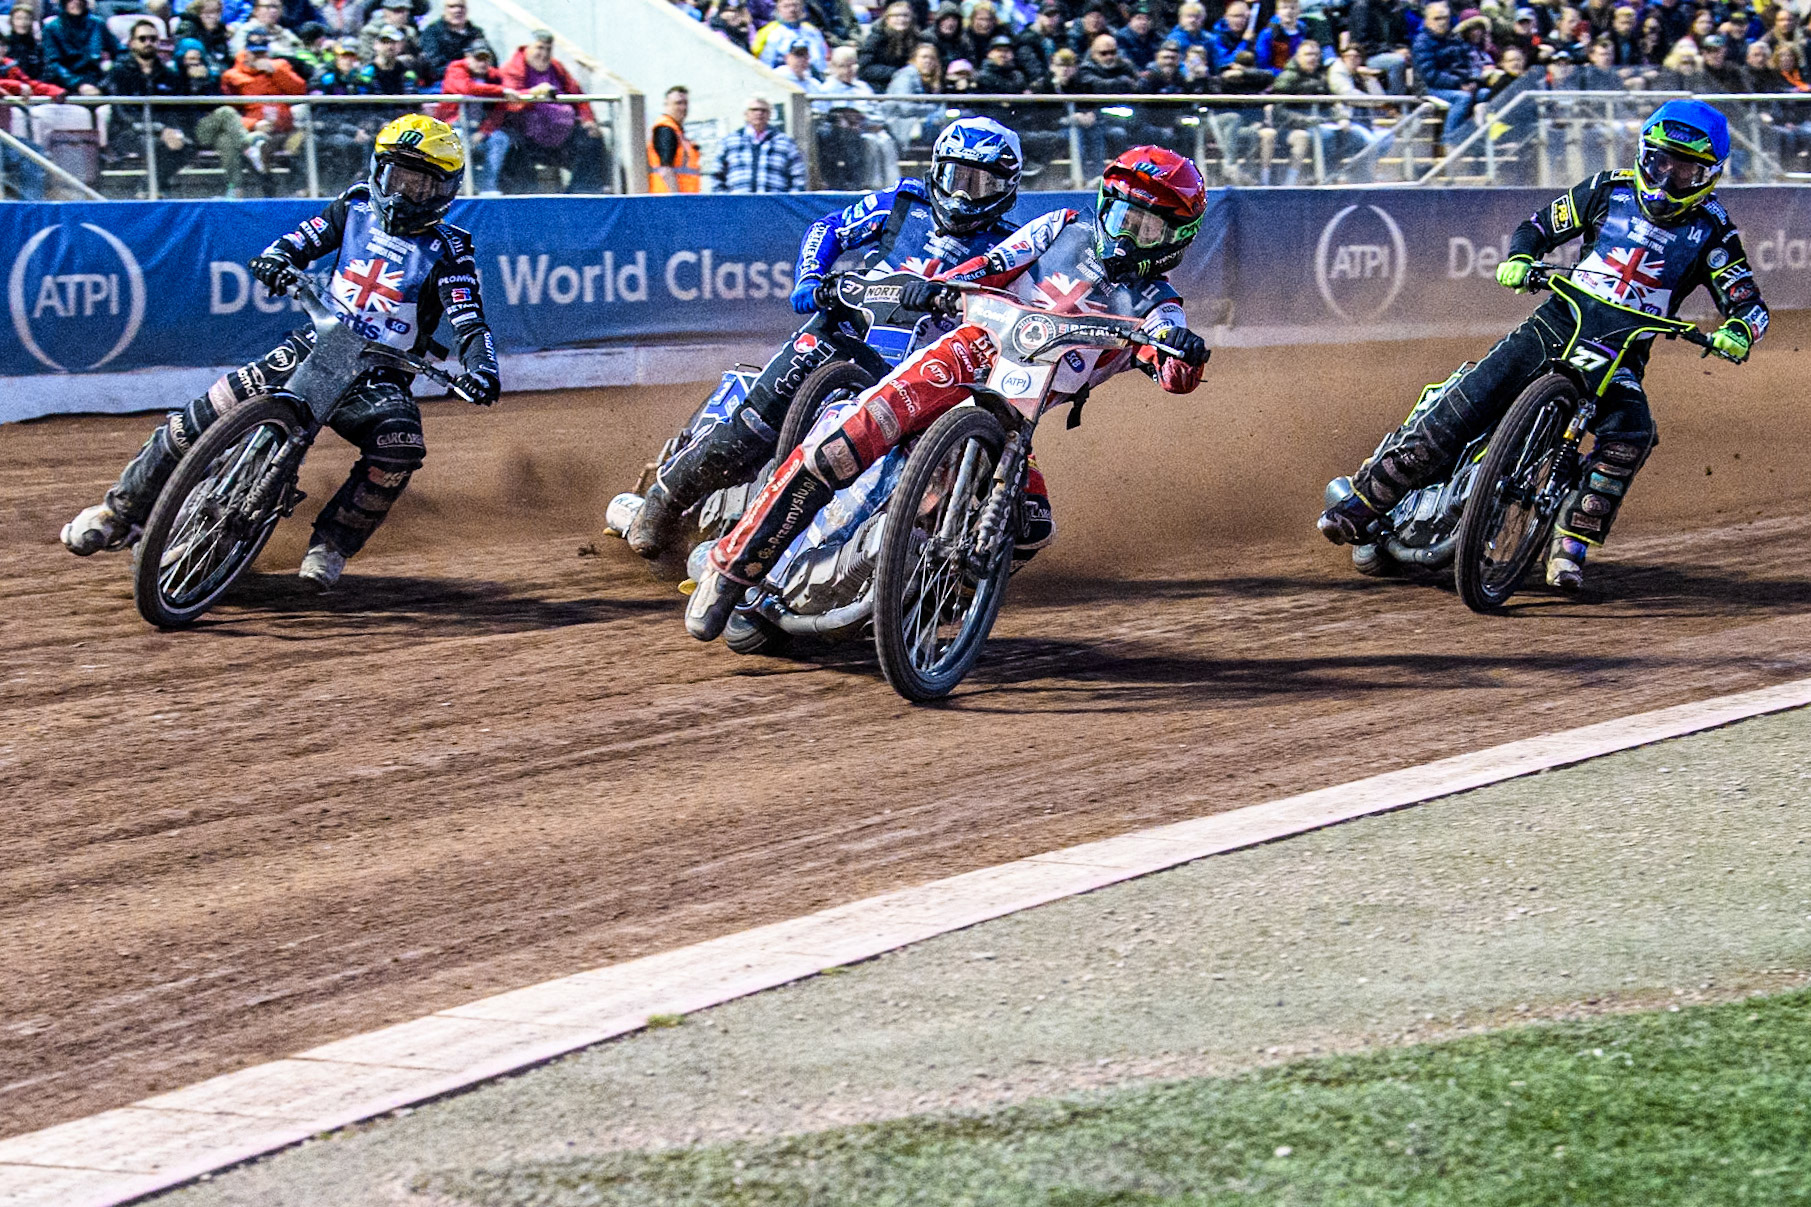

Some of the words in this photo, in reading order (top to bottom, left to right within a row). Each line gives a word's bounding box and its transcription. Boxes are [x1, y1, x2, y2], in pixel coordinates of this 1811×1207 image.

[1686, 226, 1703, 244] 14
[1756, 228, 1811, 270] cla
[1330, 244, 1391, 280] ATPI
[497, 250, 648, 304] World
[664, 248, 793, 301] Class
[32, 273, 120, 318] ATPI
[840, 280, 865, 296] 37
[1066, 352, 1082, 368] SCB
[1568, 345, 1609, 372] 27
[927, 363, 947, 383] ATPI
[1004, 378, 1027, 388] ATPI
